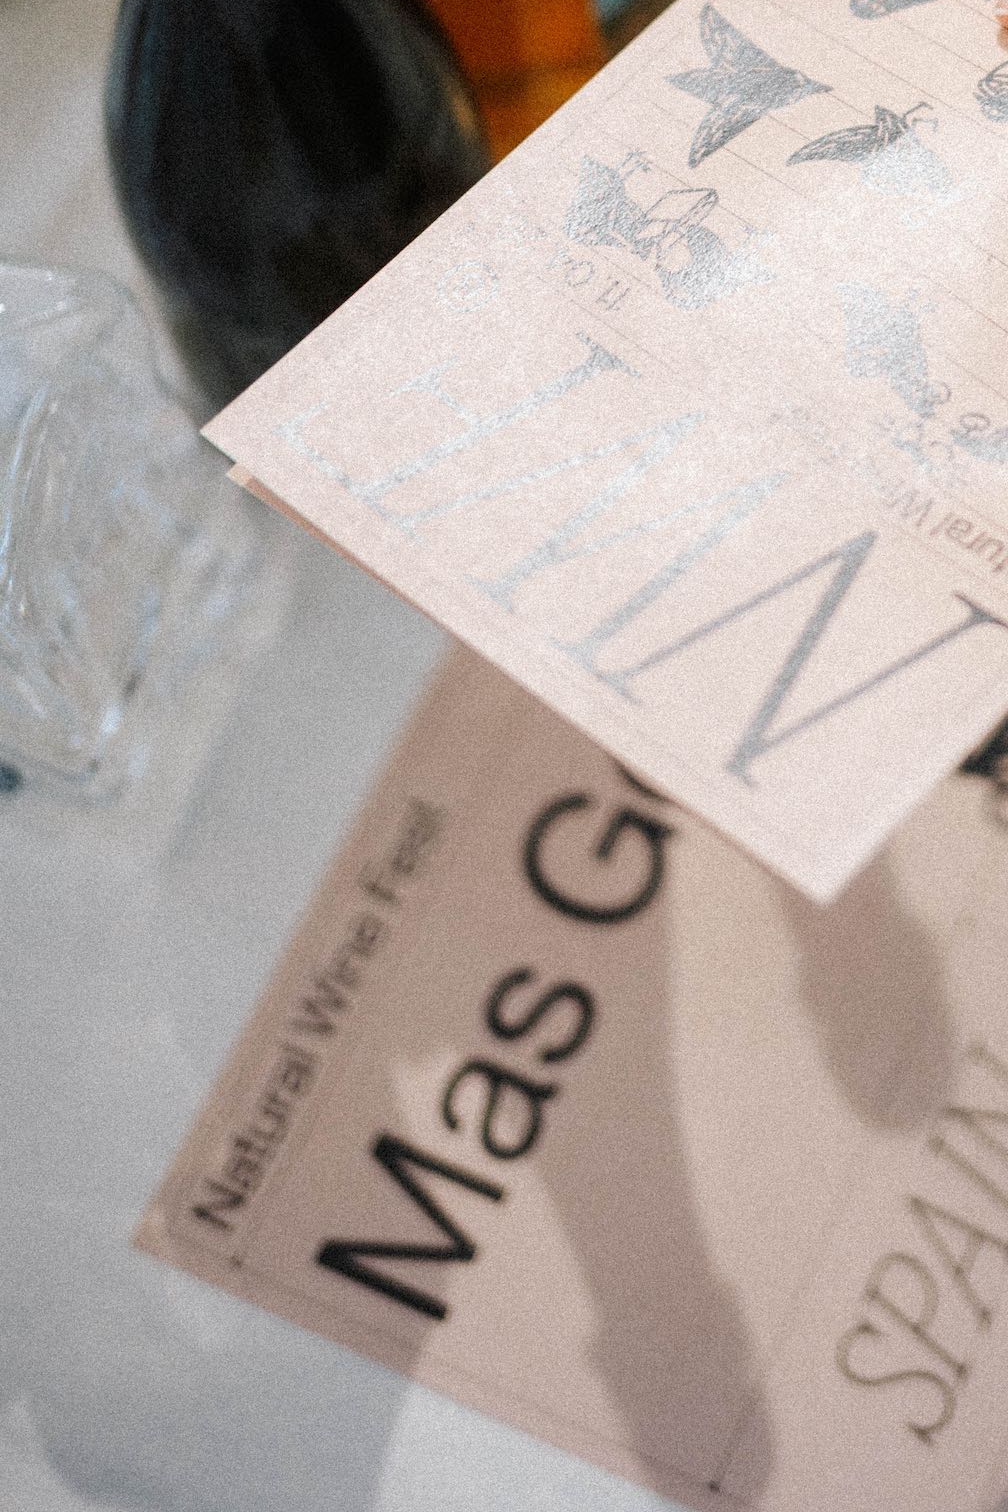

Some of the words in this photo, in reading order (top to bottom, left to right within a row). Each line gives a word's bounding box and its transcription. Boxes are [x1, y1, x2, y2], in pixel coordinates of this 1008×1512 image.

[192, 1041, 318, 1231] Natural
[316, 964, 597, 1321] Mas
[522, 763, 678, 925] G
